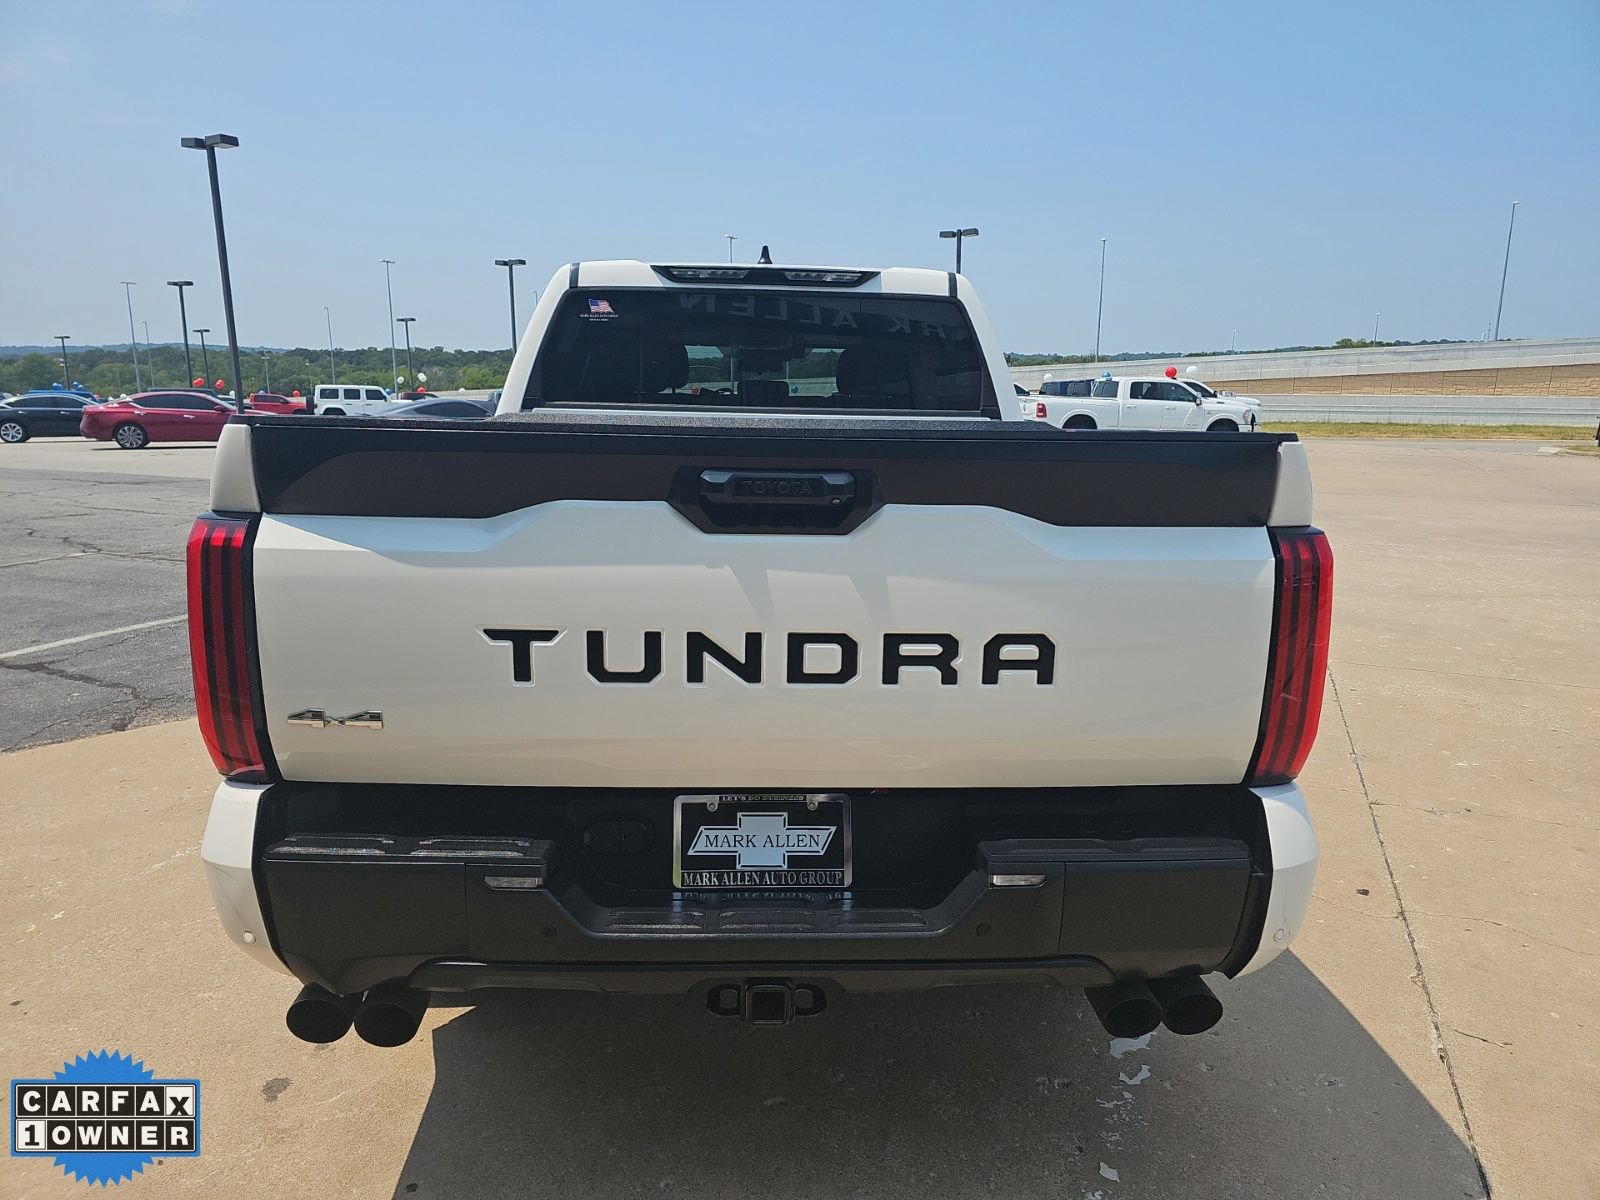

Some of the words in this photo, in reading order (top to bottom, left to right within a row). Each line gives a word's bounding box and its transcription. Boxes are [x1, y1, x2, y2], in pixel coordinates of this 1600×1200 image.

[741, 480, 813, 495] TOYOTA
[481, 629, 1056, 687] TUNDRA
[704, 834, 758, 848] MARK
[762, 834, 821, 848] ALLEN
[683, 872, 719, 886] MARK
[721, 871, 760, 886] ALLEN
[762, 871, 797, 885] AUTO
[799, 871, 843, 885] GROUP
